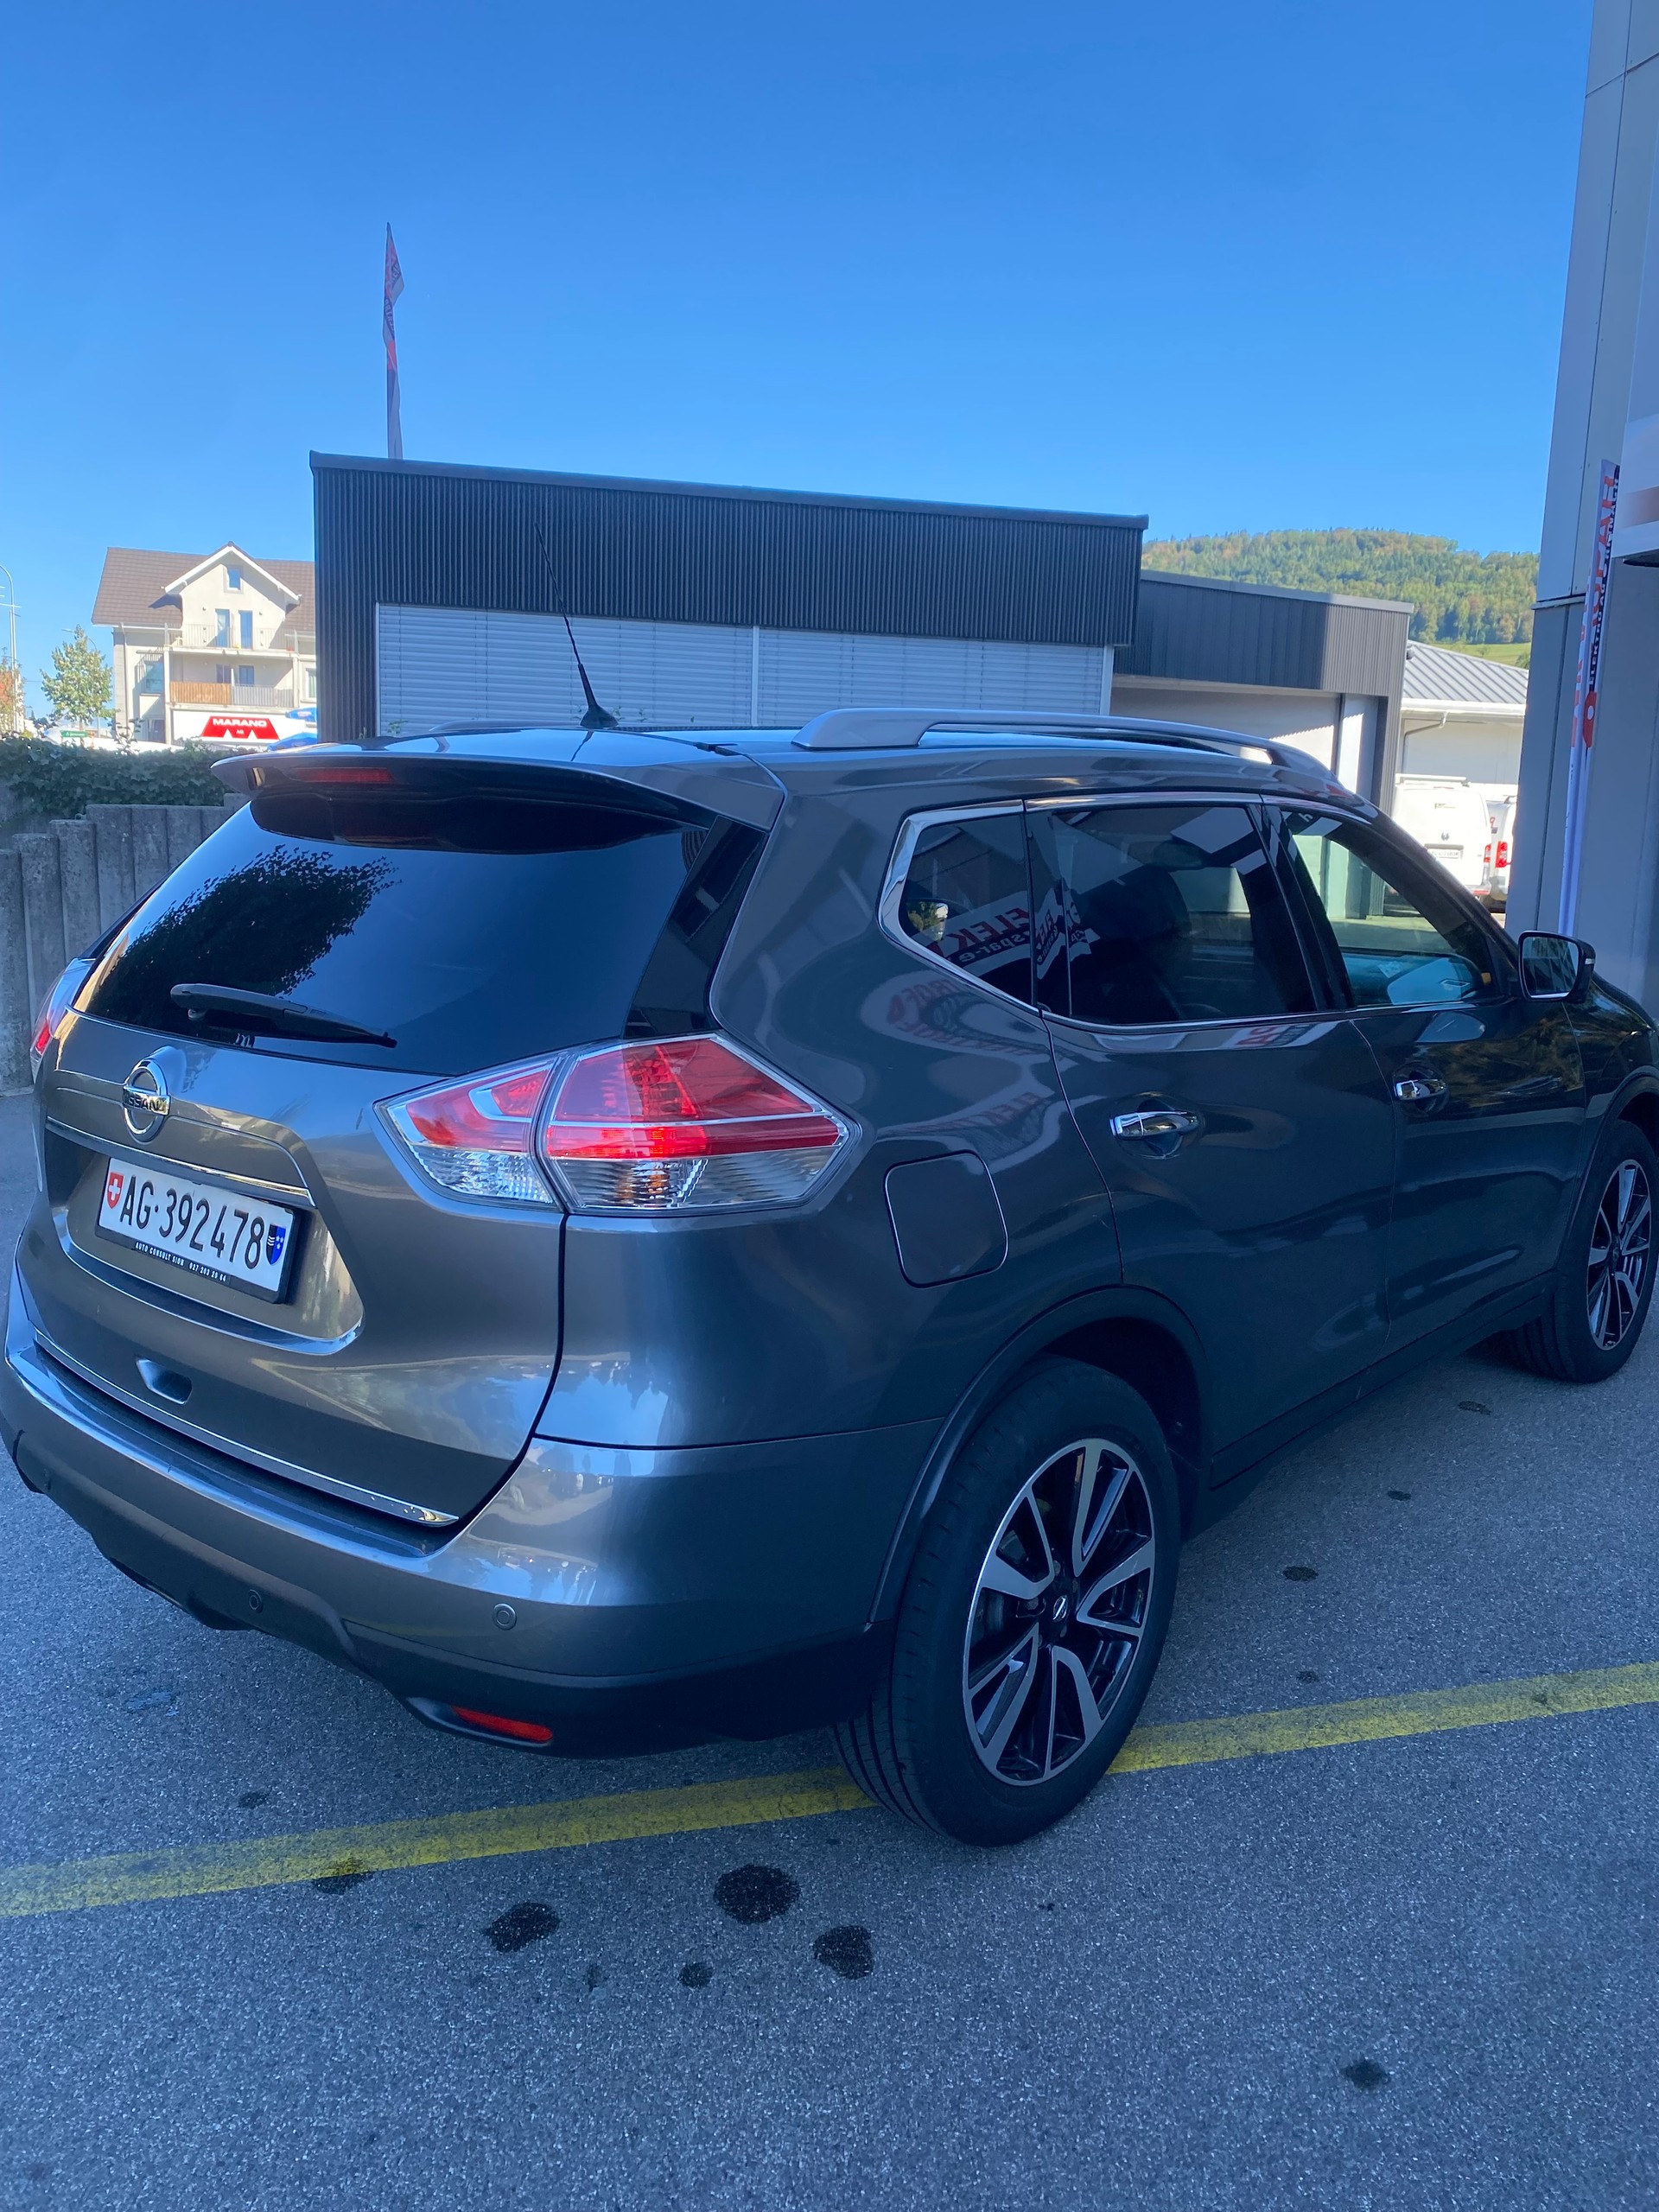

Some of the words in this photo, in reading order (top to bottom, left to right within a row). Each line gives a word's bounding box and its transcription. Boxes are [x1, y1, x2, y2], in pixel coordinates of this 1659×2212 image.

[213, 718, 267, 728] MARANO
[125, 1092, 160, 1111] SSAN
[135, 1242, 149, 1253] AUTO
[149, 1247, 171, 1262] CONSULT
[172, 1255, 185, 1266] SION
[189, 1262, 199, 1272] 027
